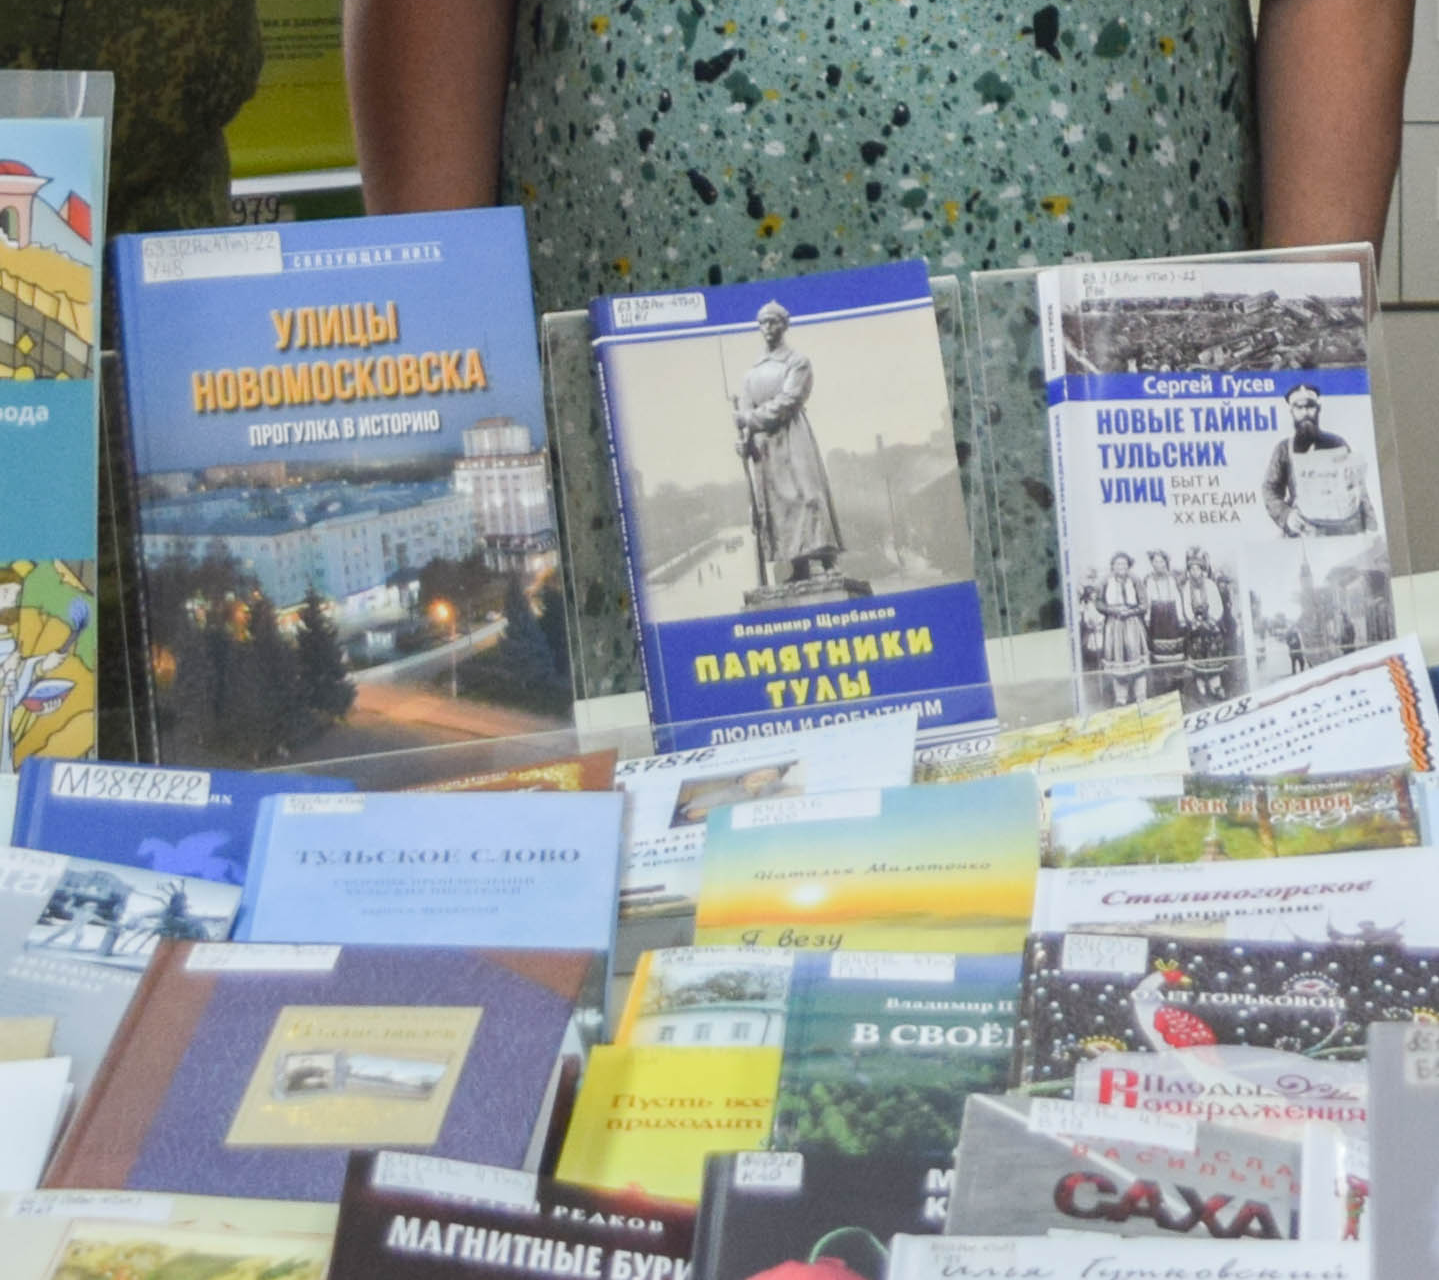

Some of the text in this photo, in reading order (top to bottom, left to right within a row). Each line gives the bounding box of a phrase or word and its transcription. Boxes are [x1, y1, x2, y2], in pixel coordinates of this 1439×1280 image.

[270, 300, 400, 351] УЛИЦЫ
[191, 348, 488, 414] НОВОМОСКОВСКА
[1143, 372, 1276, 399] Сергей Гусев
[248, 409, 441, 447] ПРОГУЛКА В ИСТОРИЮ
[1096, 401, 1278, 436] НОВЫЕ ТАЙНЫ
[1097, 440, 1228, 470] ТУЛЬСКИХ
[1099, 474, 1220, 507] УЛИЦ БЫТ И
[1171, 492, 1257, 507] ТРАГЕДИИ
[1200, 509, 1241, 523] ВЕКА
[733, 606, 896, 639] Владимир Щербаков
[694, 626, 934, 683] ПАМЯТНИКИ
[766, 670, 871, 709] ТУЛЫ
[470, 847, 582, 865] СЛОВО
[851, 1018, 1013, 1048] В СВОЁ
[1053, 1170, 1283, 1241] САХА
[385, 1214, 603, 1280] МАГНИТНЫЕ
